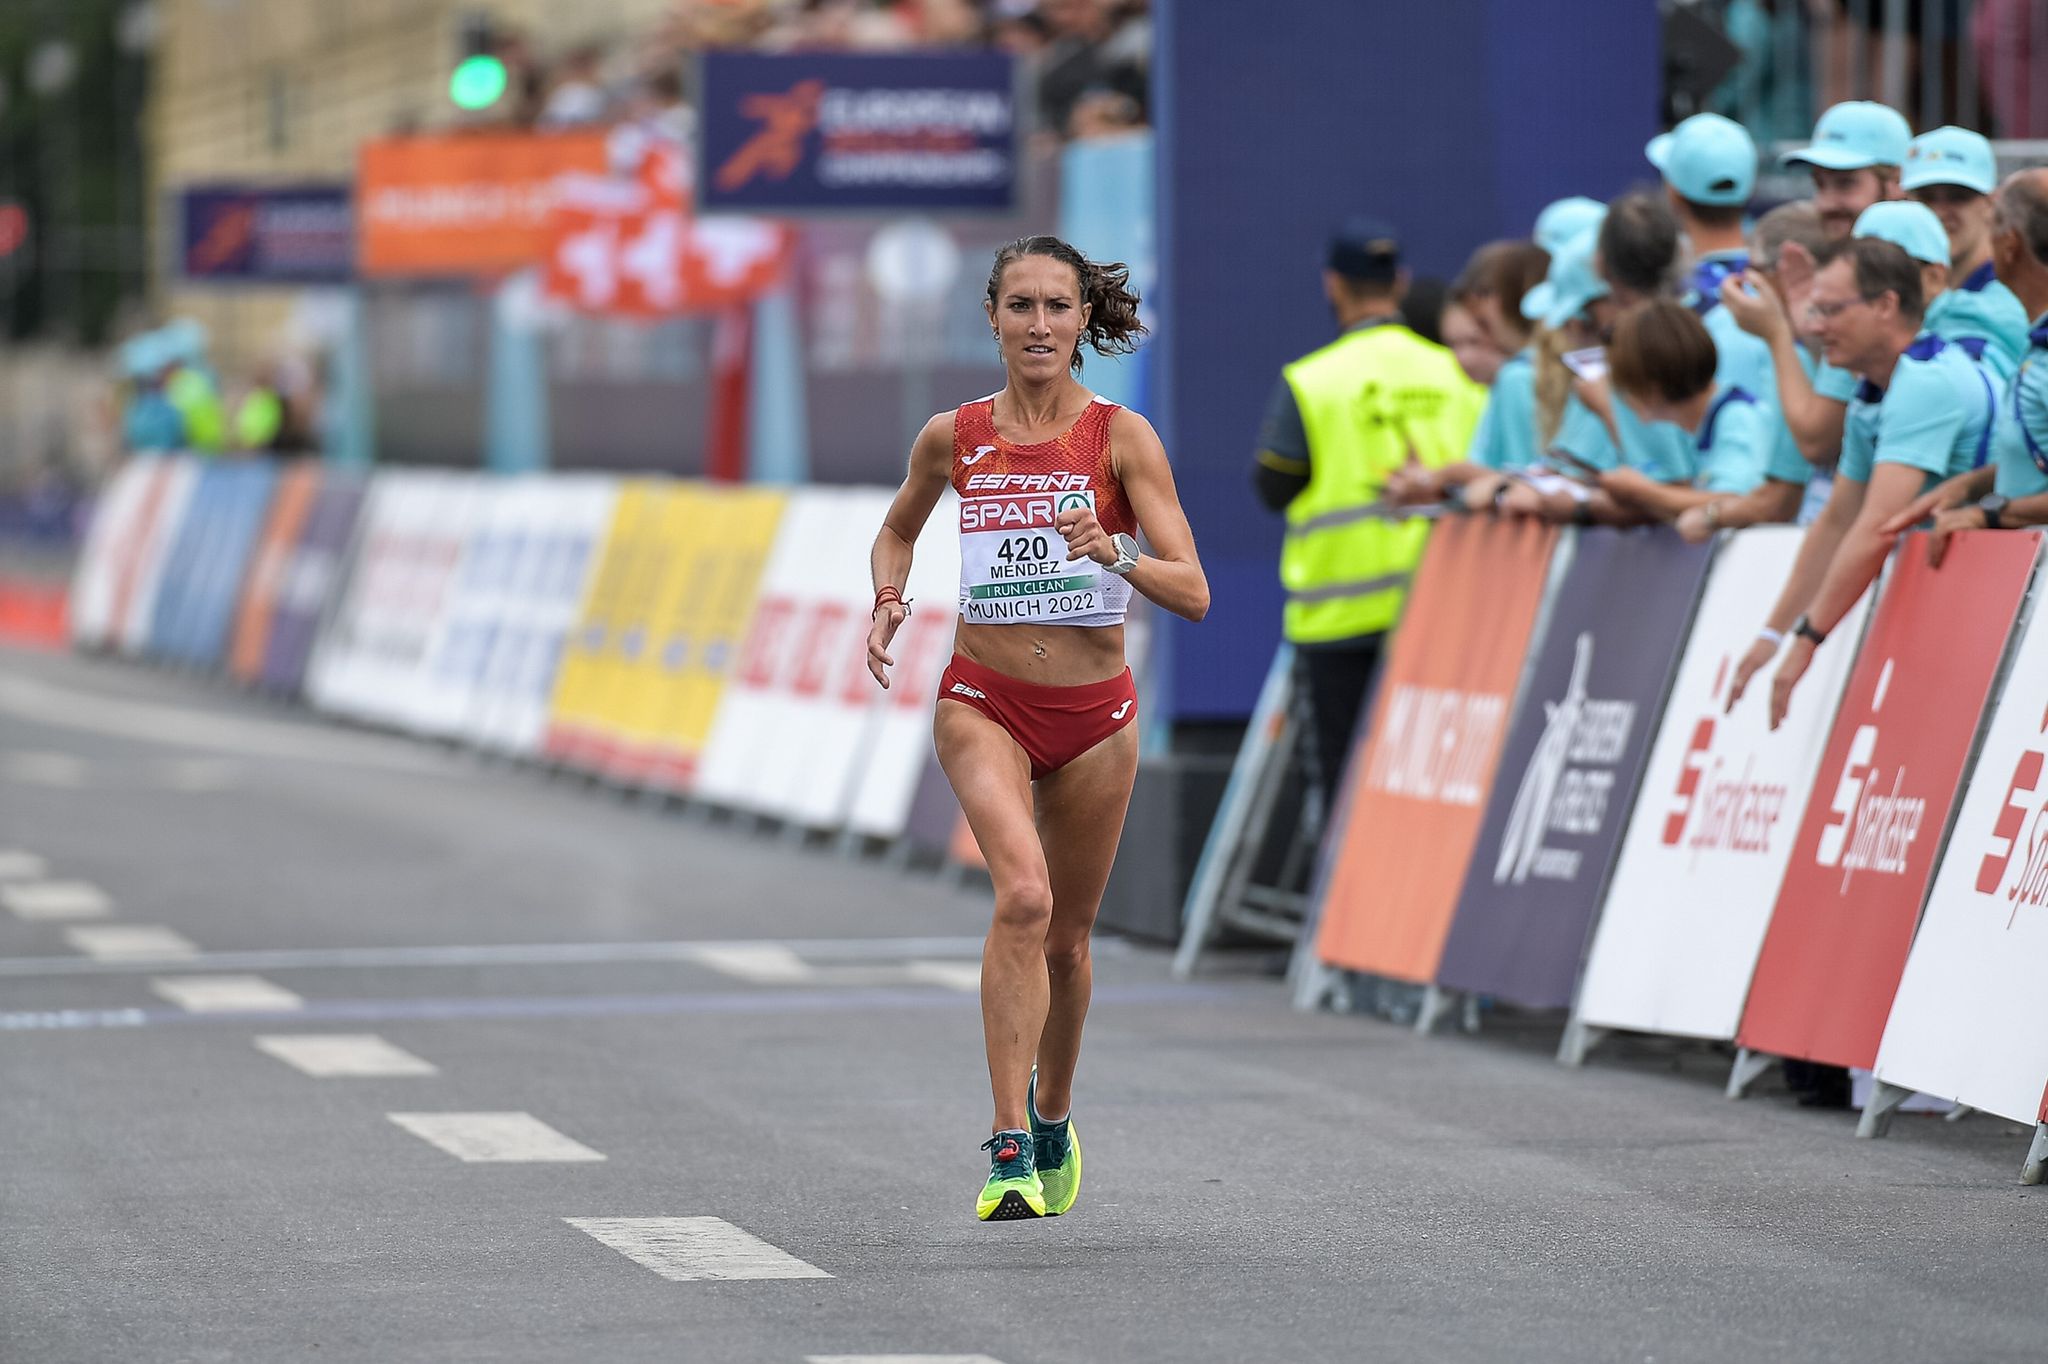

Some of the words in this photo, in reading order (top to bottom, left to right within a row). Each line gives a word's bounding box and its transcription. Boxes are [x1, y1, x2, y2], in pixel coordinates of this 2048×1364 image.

[965, 471, 1091, 490] ESPAÑA
[962, 500, 1053, 529] SPAR
[997, 536, 1049, 562] 420
[986, 586, 991, 597] I
[994, 584, 1021, 597] RUN
[968, 600, 1041, 618] MUNICH
[1048, 593, 1095, 614] 2022
[950, 682, 987, 700] ESP
[1842, 765, 1926, 896] Sparkasse
